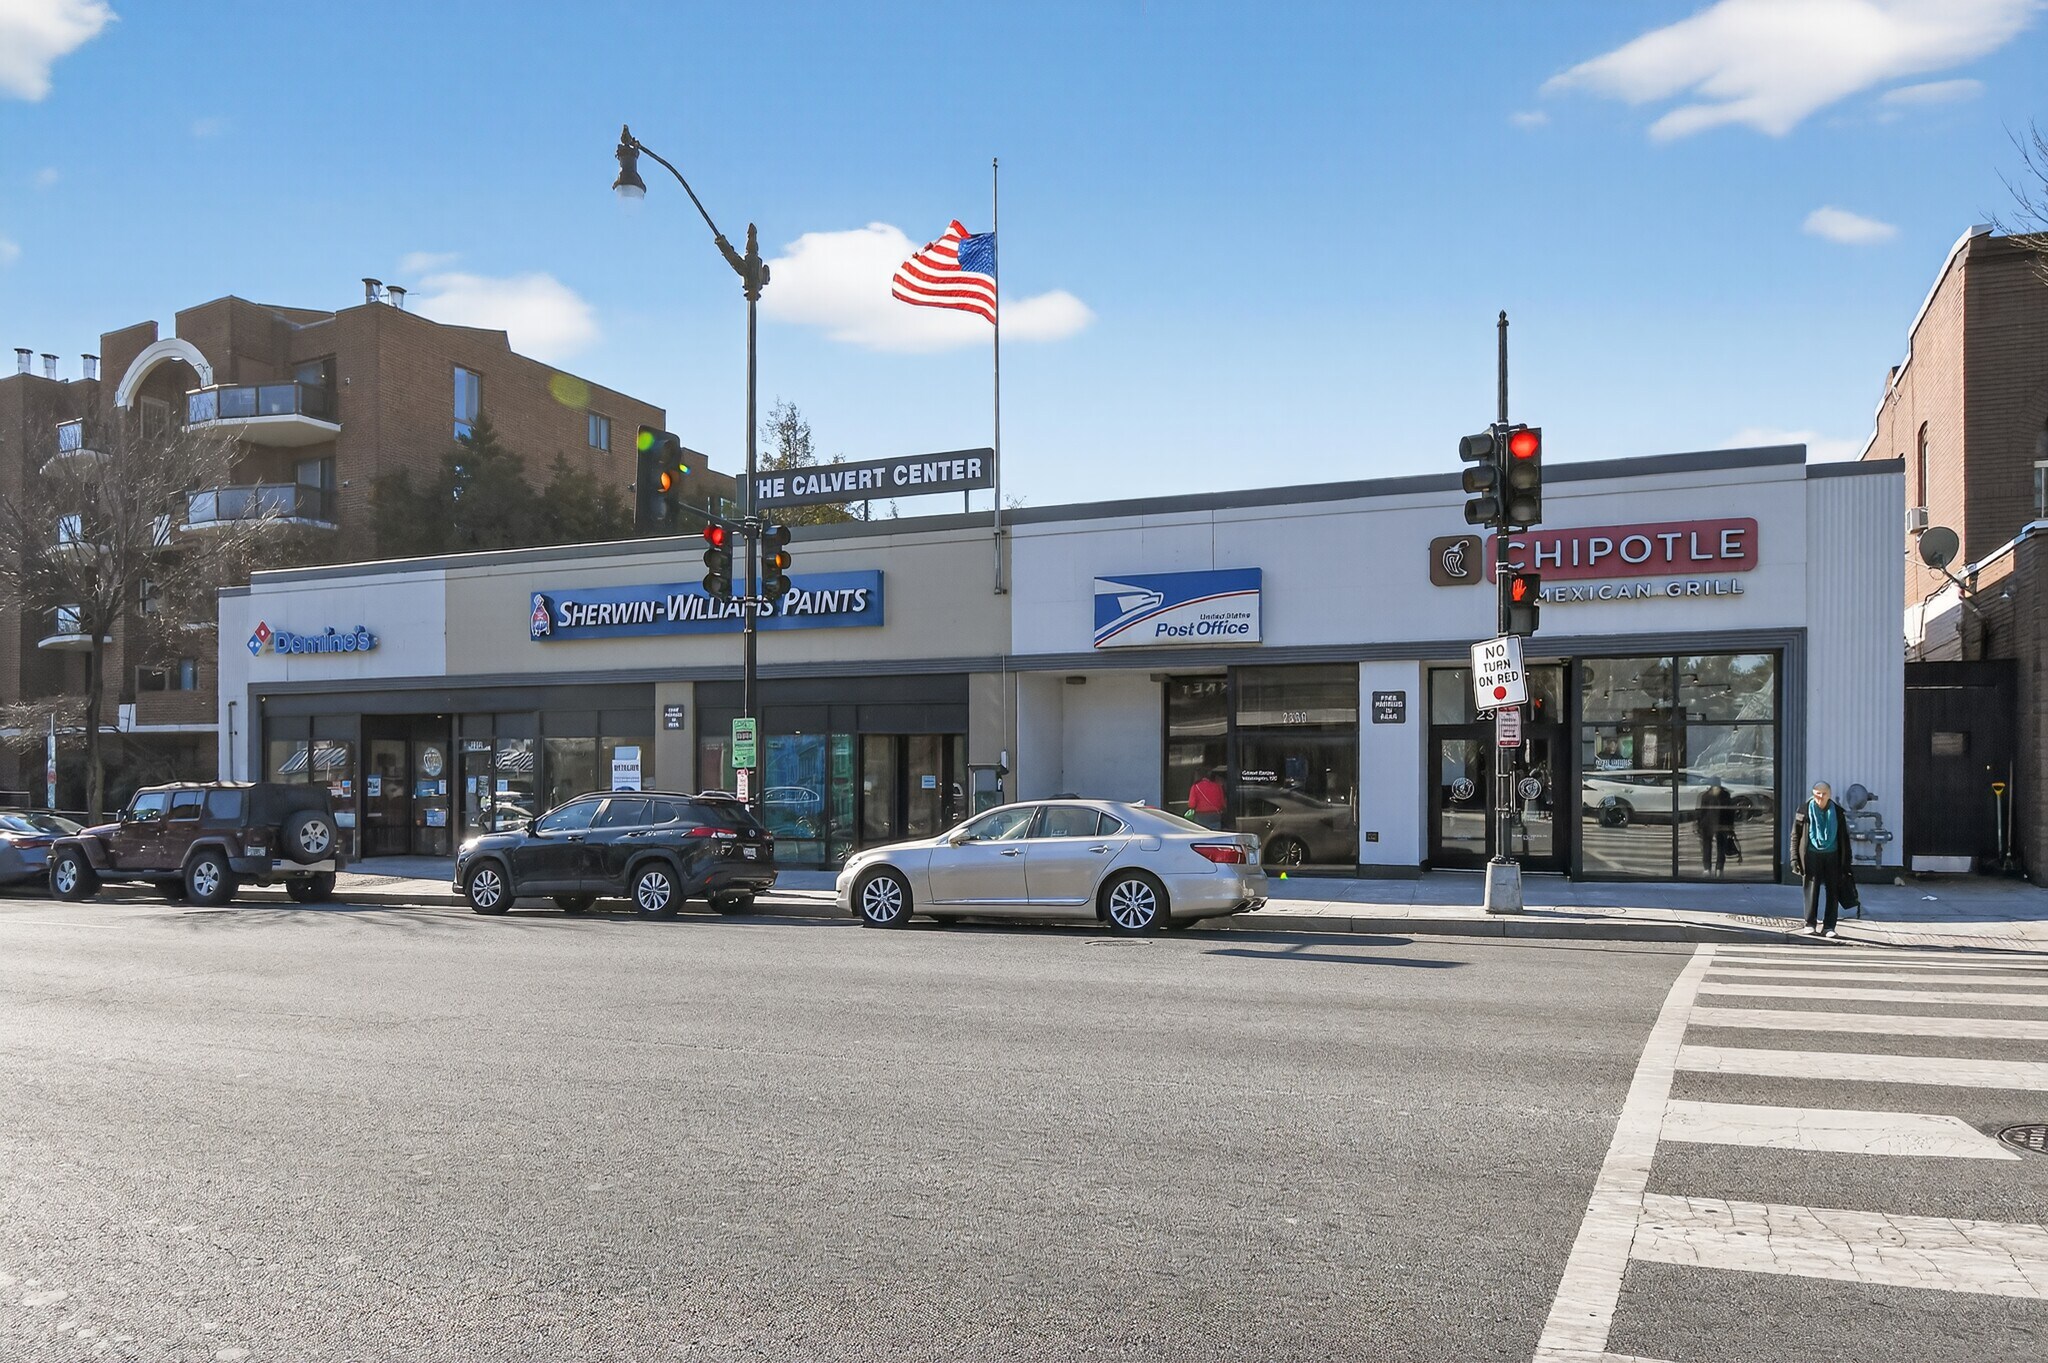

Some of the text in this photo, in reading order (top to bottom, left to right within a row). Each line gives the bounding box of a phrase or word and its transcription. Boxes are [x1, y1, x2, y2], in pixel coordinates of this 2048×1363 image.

[756, 458, 982, 499] HE CALVERT CENTER
[1666, 579, 1745, 597] GRILL
[782, 588, 867, 615] PAINTS
[1155, 620, 1249, 637] Post Office
[274, 625, 370, 654] Domino's
[1485, 644, 1505, 659] NO
[1483, 659, 1511, 673] TURN
[1479, 671, 1519, 687] ON RED
